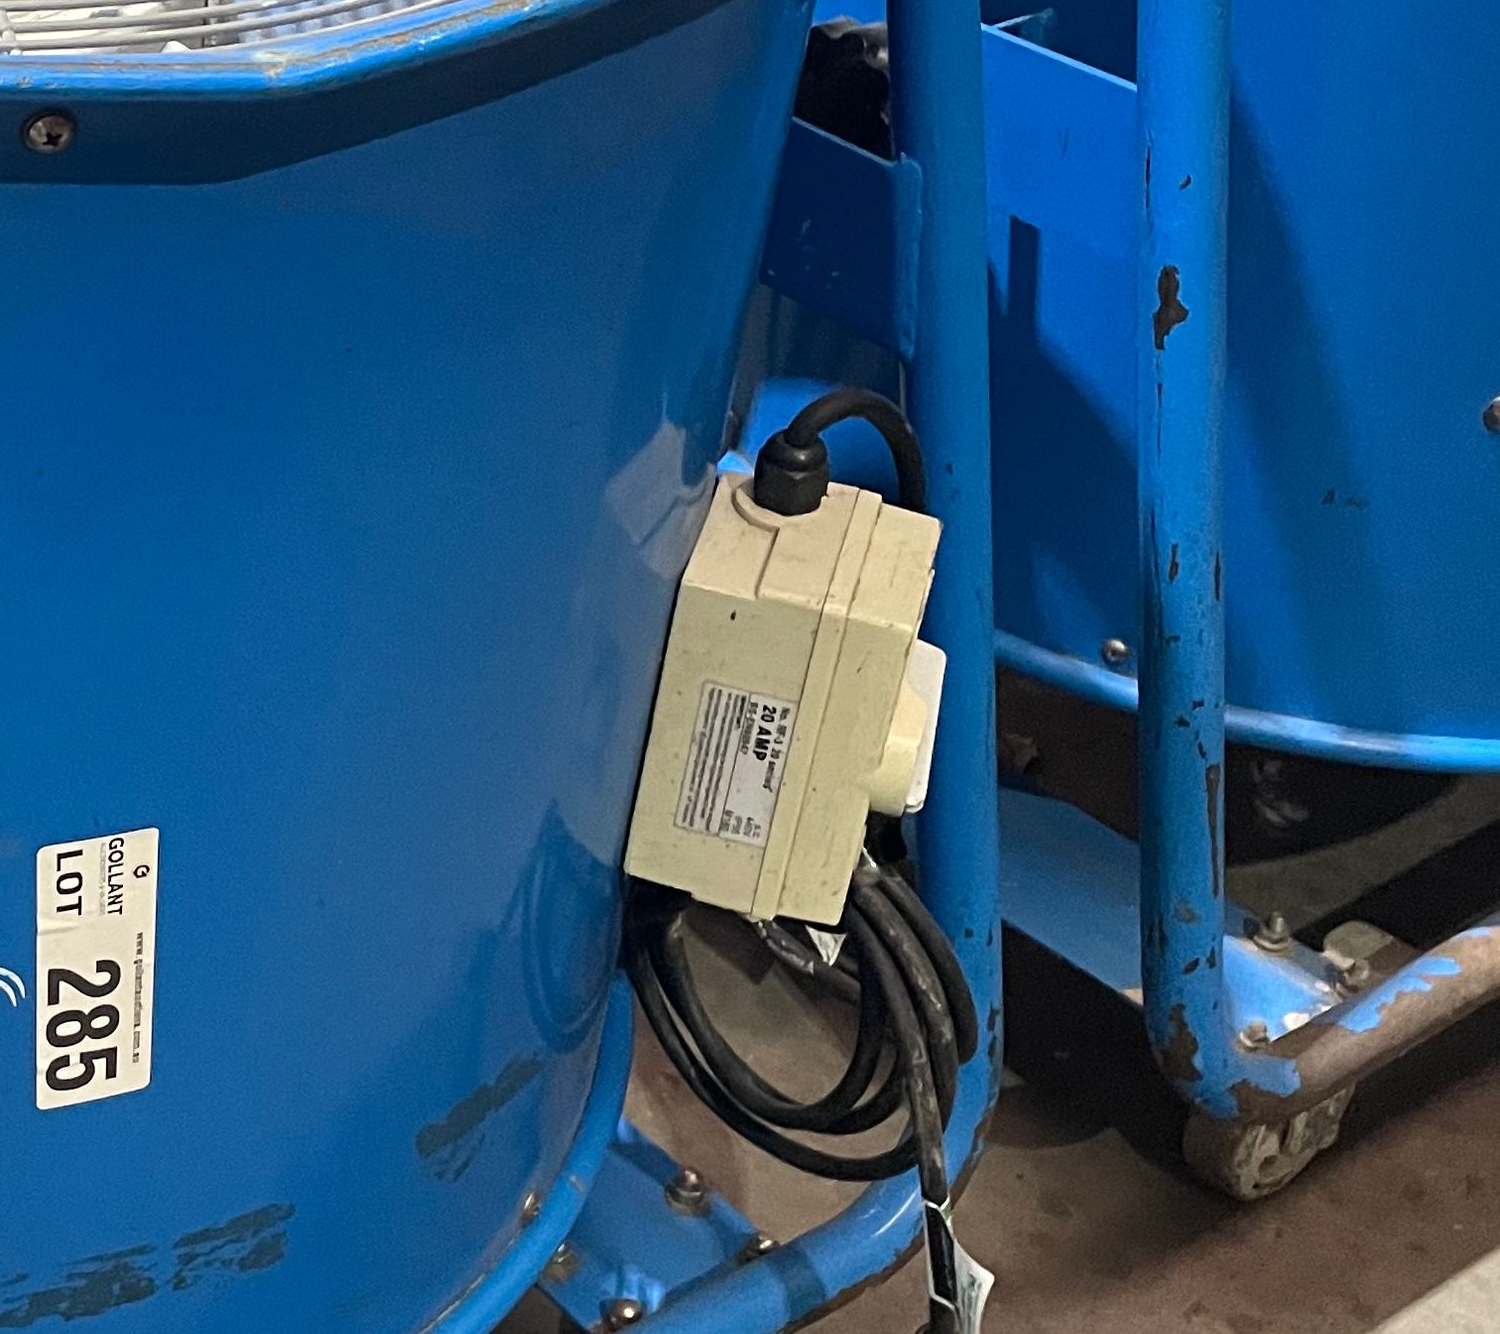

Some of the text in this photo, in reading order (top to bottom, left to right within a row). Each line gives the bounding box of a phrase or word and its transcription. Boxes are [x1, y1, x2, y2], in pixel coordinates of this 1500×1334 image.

[752, 704, 777, 762] 20 AMP
[56, 849, 83, 916] LOT
[106, 837, 125, 916] GOLLANT
[45, 959, 122, 1092] 285
